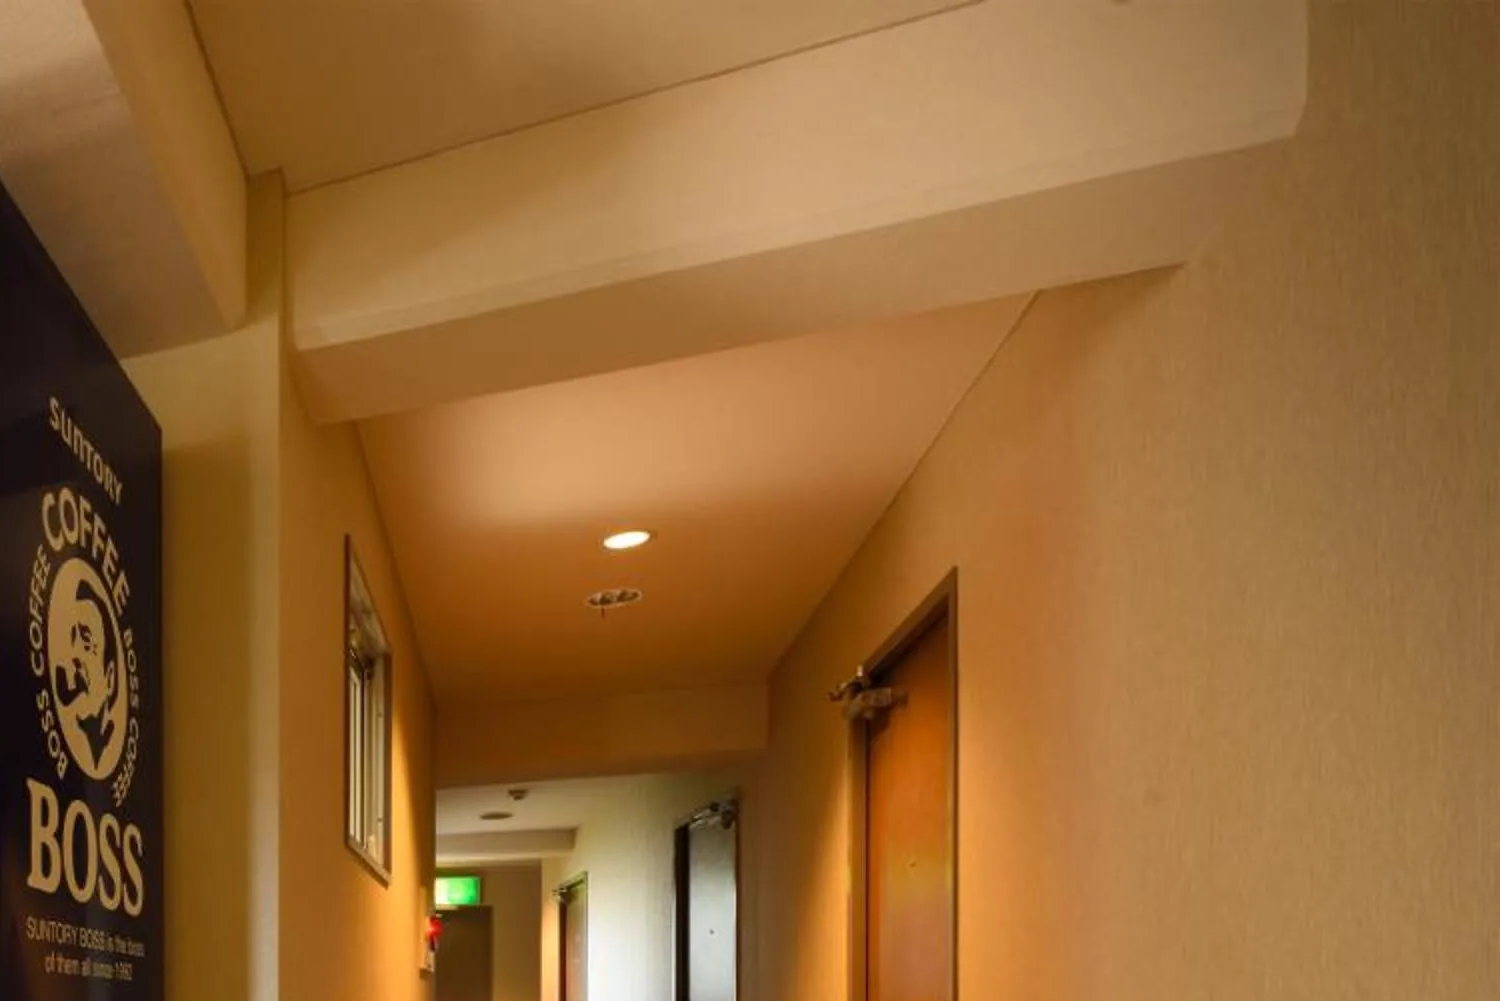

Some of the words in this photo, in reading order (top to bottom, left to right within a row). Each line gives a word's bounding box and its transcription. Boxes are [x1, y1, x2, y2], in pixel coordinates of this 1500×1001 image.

[28, 543, 51, 678] COFFEE
[41, 486, 130, 617] COFFEE
[35, 688, 68, 780] BOSS
[26, 777, 144, 917] BOSS
[26, 916, 78, 945] SUNTORY
[80, 927, 105, 951] BOSS
